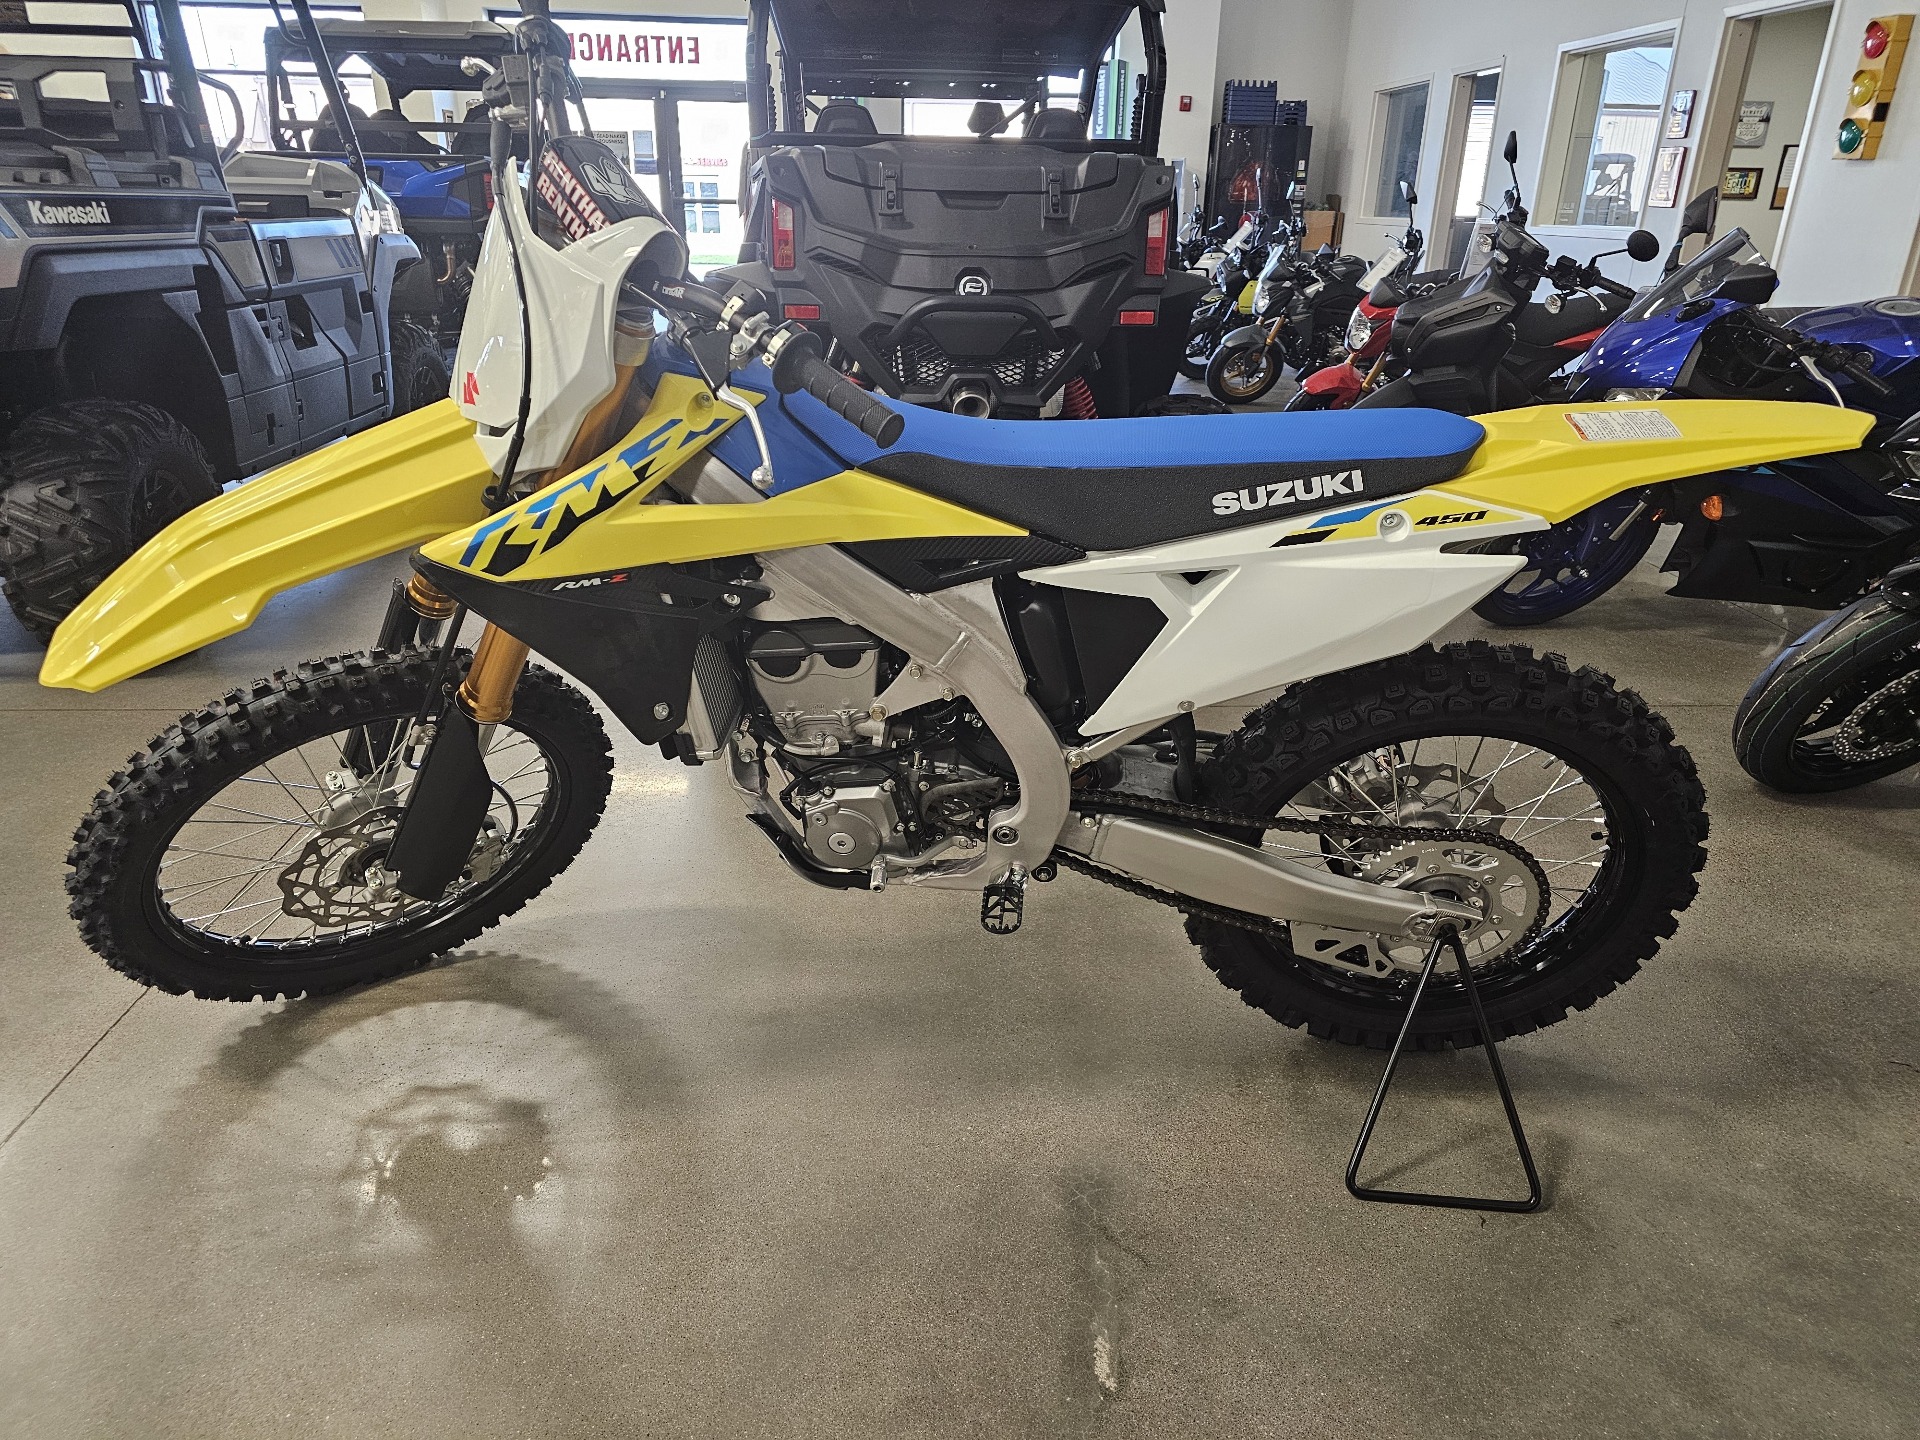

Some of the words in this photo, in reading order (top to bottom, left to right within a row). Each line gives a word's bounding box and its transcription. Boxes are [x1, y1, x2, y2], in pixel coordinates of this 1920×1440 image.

[1096, 69, 1106, 135] Kawasaki
[26, 199, 111, 225] Kawasaki
[1211, 468, 1364, 516] SUZUKI
[1414, 509, 1490, 527] 450
[552, 573, 630, 592] RM-Z
